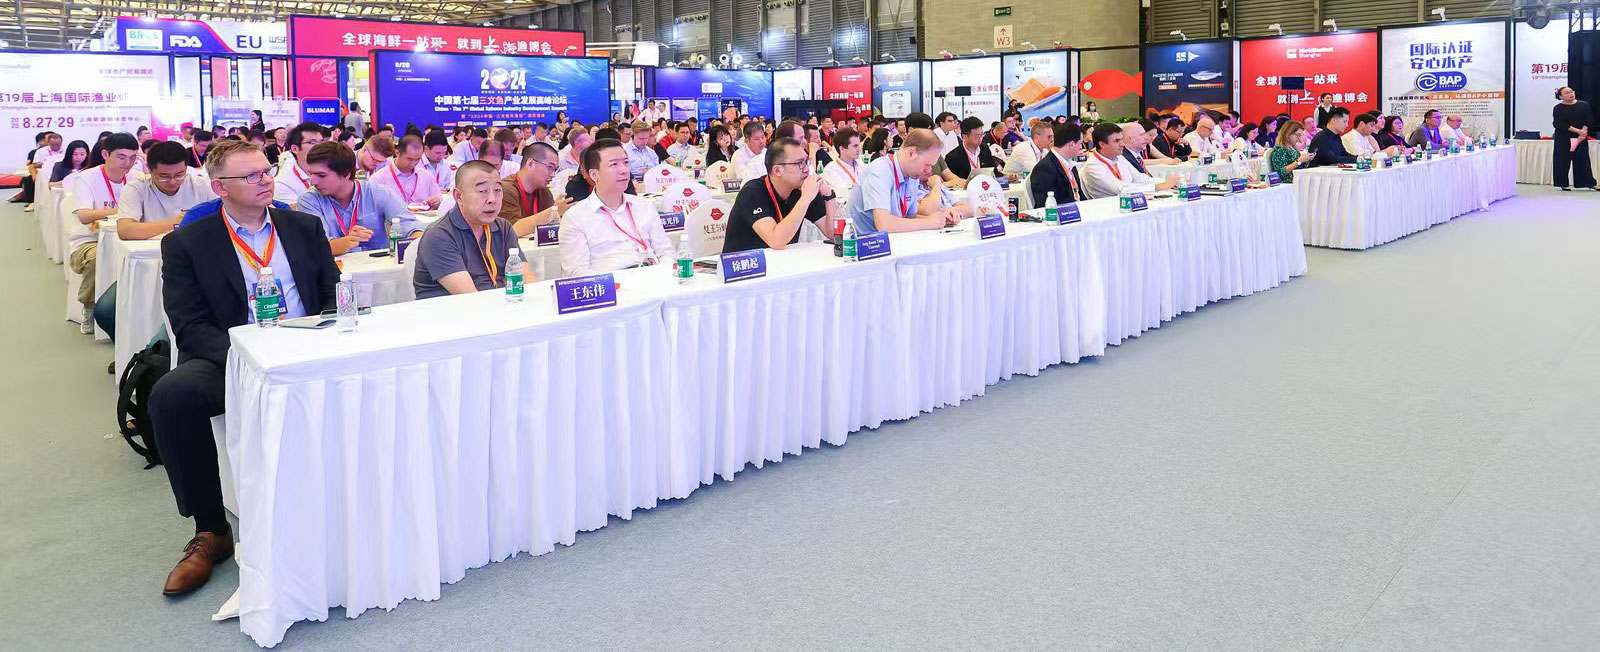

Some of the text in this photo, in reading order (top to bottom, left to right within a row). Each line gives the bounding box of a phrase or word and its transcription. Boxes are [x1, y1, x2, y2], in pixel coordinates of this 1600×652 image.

[170, 35, 203, 48] FDA
[237, 35, 262, 49] EU
[997, 36, 1011, 46] W3
[1410, 41, 1472, 56] 国际认证
[1410, 57, 1472, 70] 安心水产
[1256, 73, 1338, 87] 全球一站采
[1439, 76, 1462, 85] BAP
[1277, 89, 1369, 105] 就到上渔博会
[731, 257, 759, 273] 徐鹏起
[569, 283, 605, 300] 王东伟
